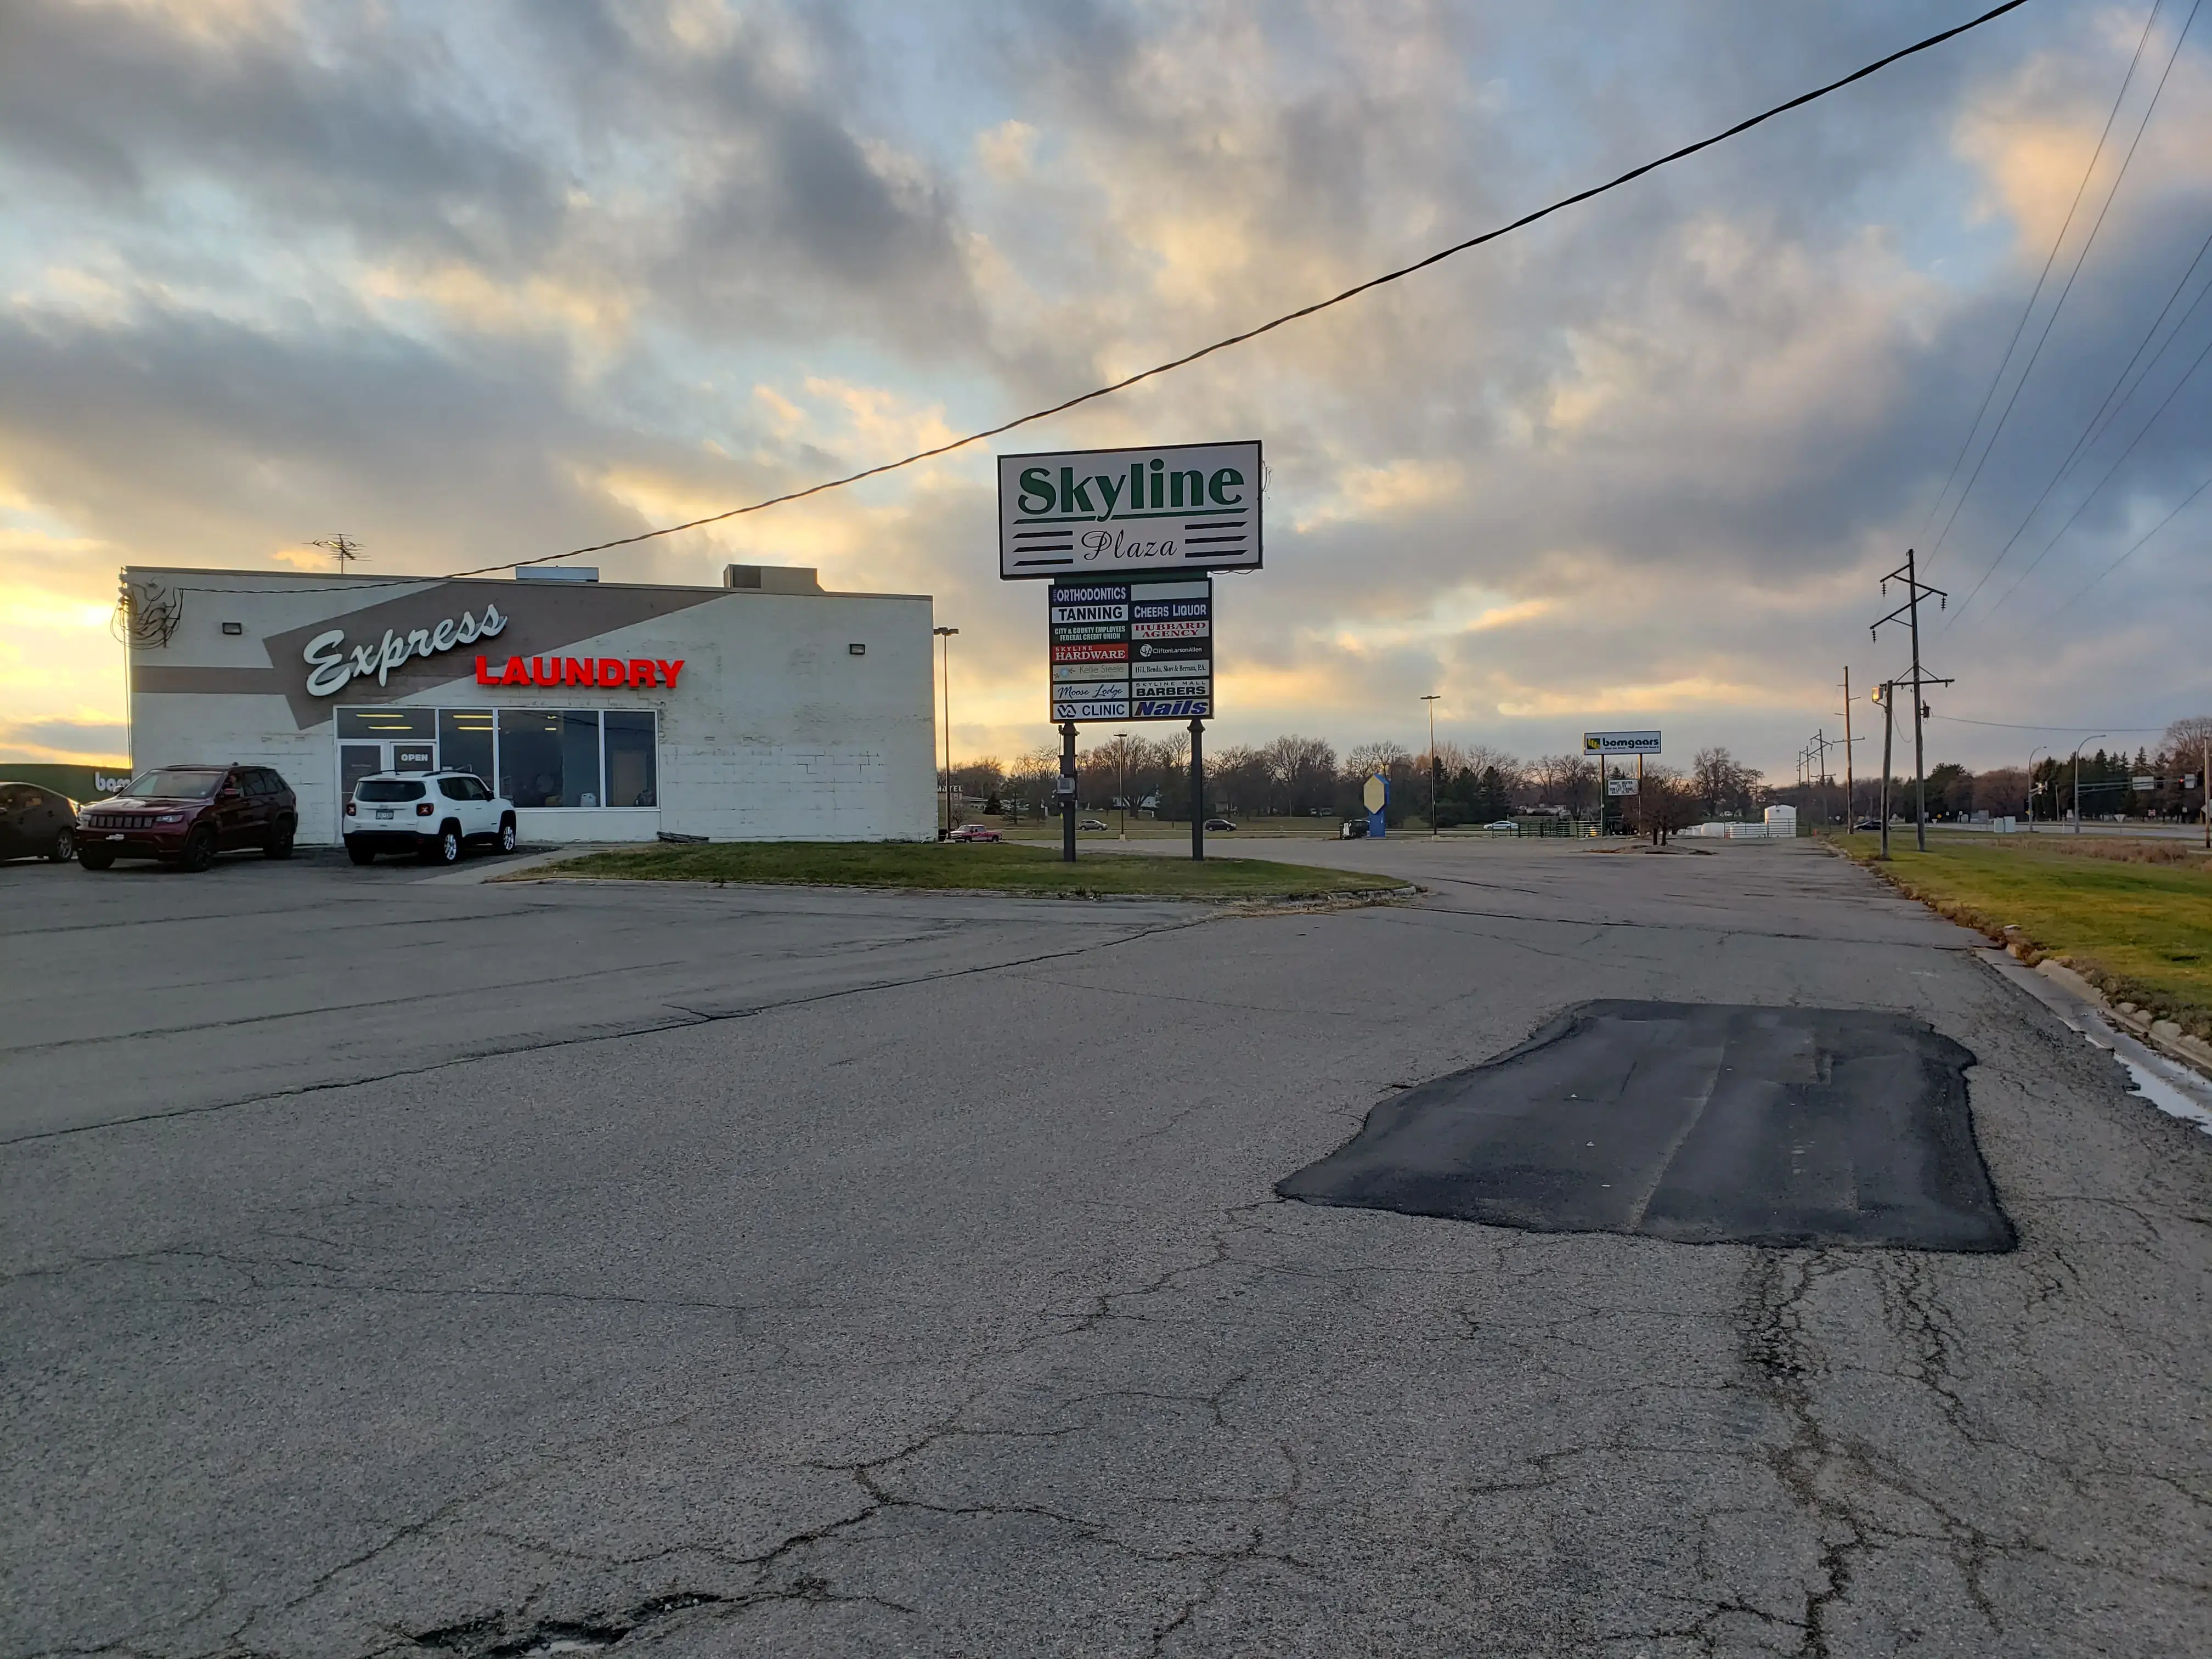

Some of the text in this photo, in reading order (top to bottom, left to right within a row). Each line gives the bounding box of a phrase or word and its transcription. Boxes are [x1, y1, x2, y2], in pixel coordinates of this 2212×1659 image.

[1018, 459, 1244, 522] Skyline
[1081, 529, 1177, 560] Plaza
[1057, 587, 1126, 602] ORTHODONTICS
[1058, 606, 1122, 620] TANNING
[1134, 604, 1206, 618] CHEERS LIQUOR
[1135, 622, 1206, 630] HUBBARD
[303, 603, 507, 697] Express
[1056, 650, 1126, 661] HARDWARE
[475, 655, 685, 688] LAUNDRY
[1101, 665, 1124, 673] Steele
[1058, 684, 1123, 699] Moose Lodge
[1136, 686, 1206, 696] BARBERS
[1082, 704, 1125, 716] CLINIC
[1135, 700, 1208, 716] Nails
[1602, 738, 1659, 748] bomgaars
